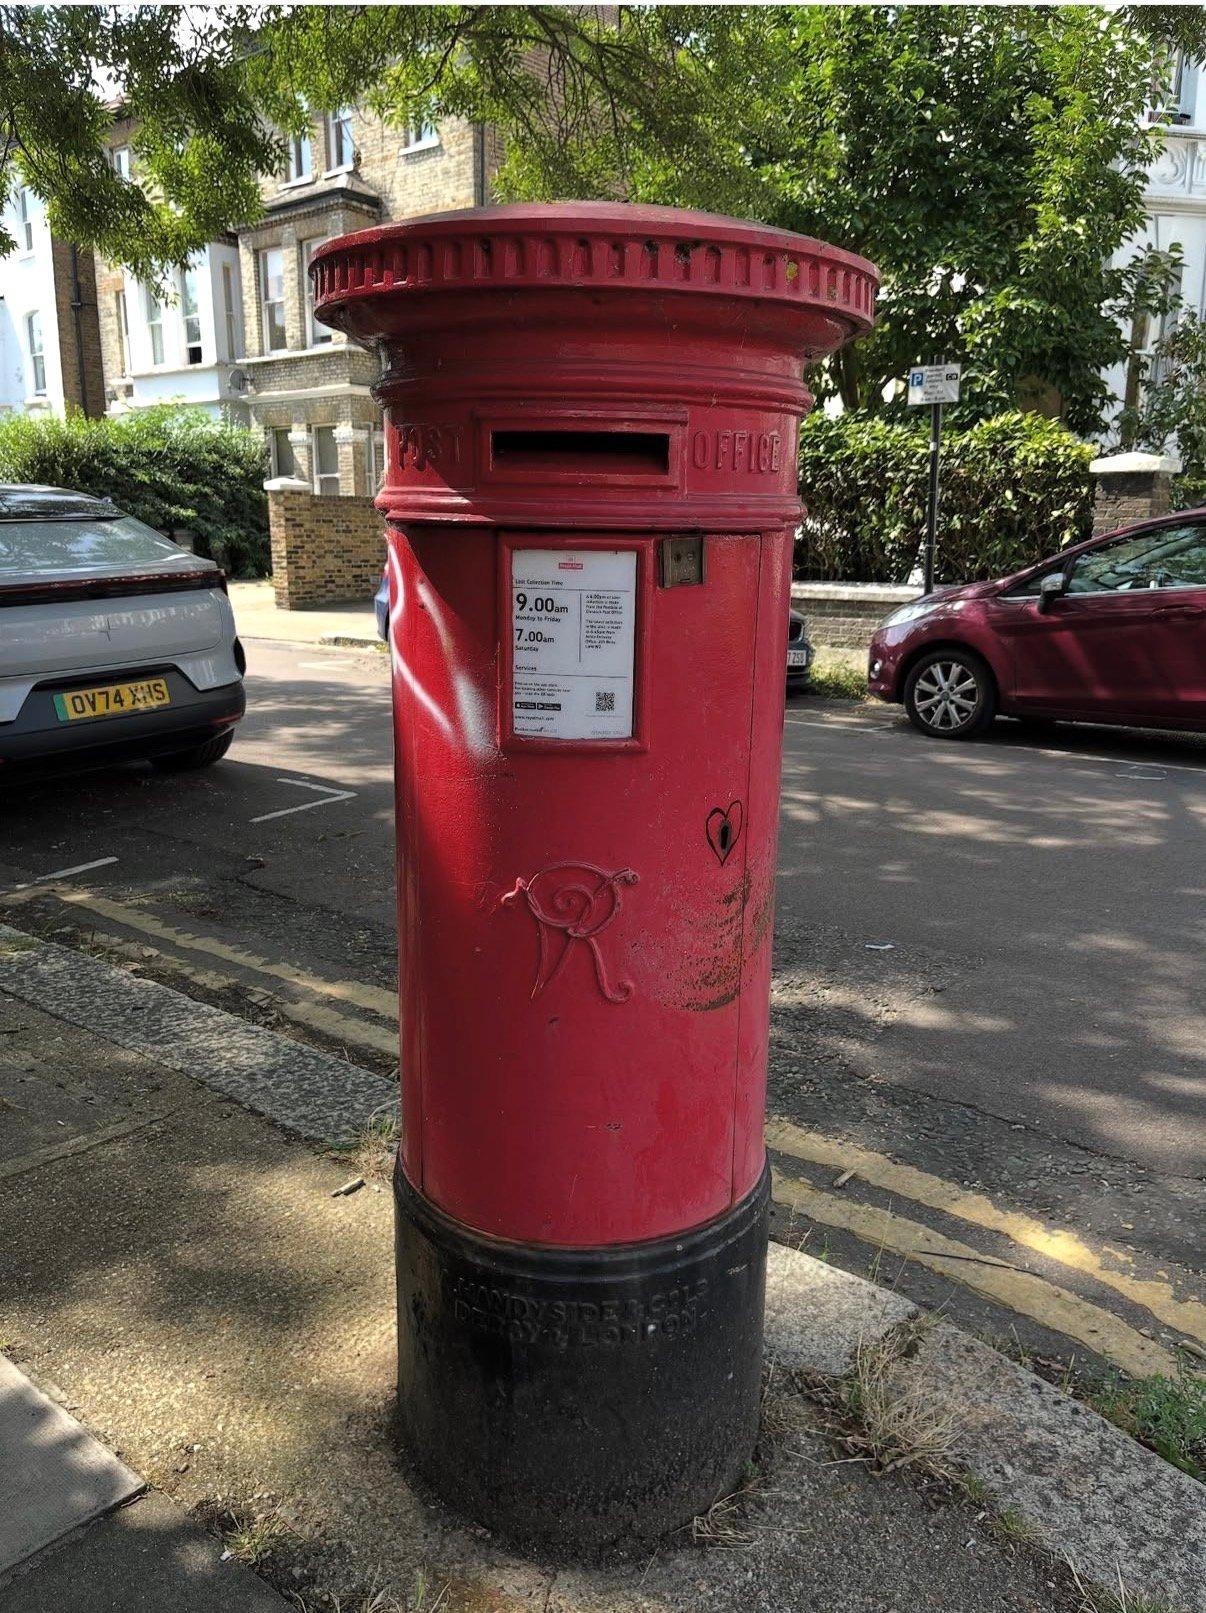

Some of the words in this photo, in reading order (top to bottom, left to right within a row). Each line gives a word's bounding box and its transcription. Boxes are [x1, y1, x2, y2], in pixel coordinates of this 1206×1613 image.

[692, 429, 782, 474] OFFICE
[516, 592, 569, 613] 9.00am
[515, 628, 555, 643] 7.00am
[71, 691, 124, 714] OV74
